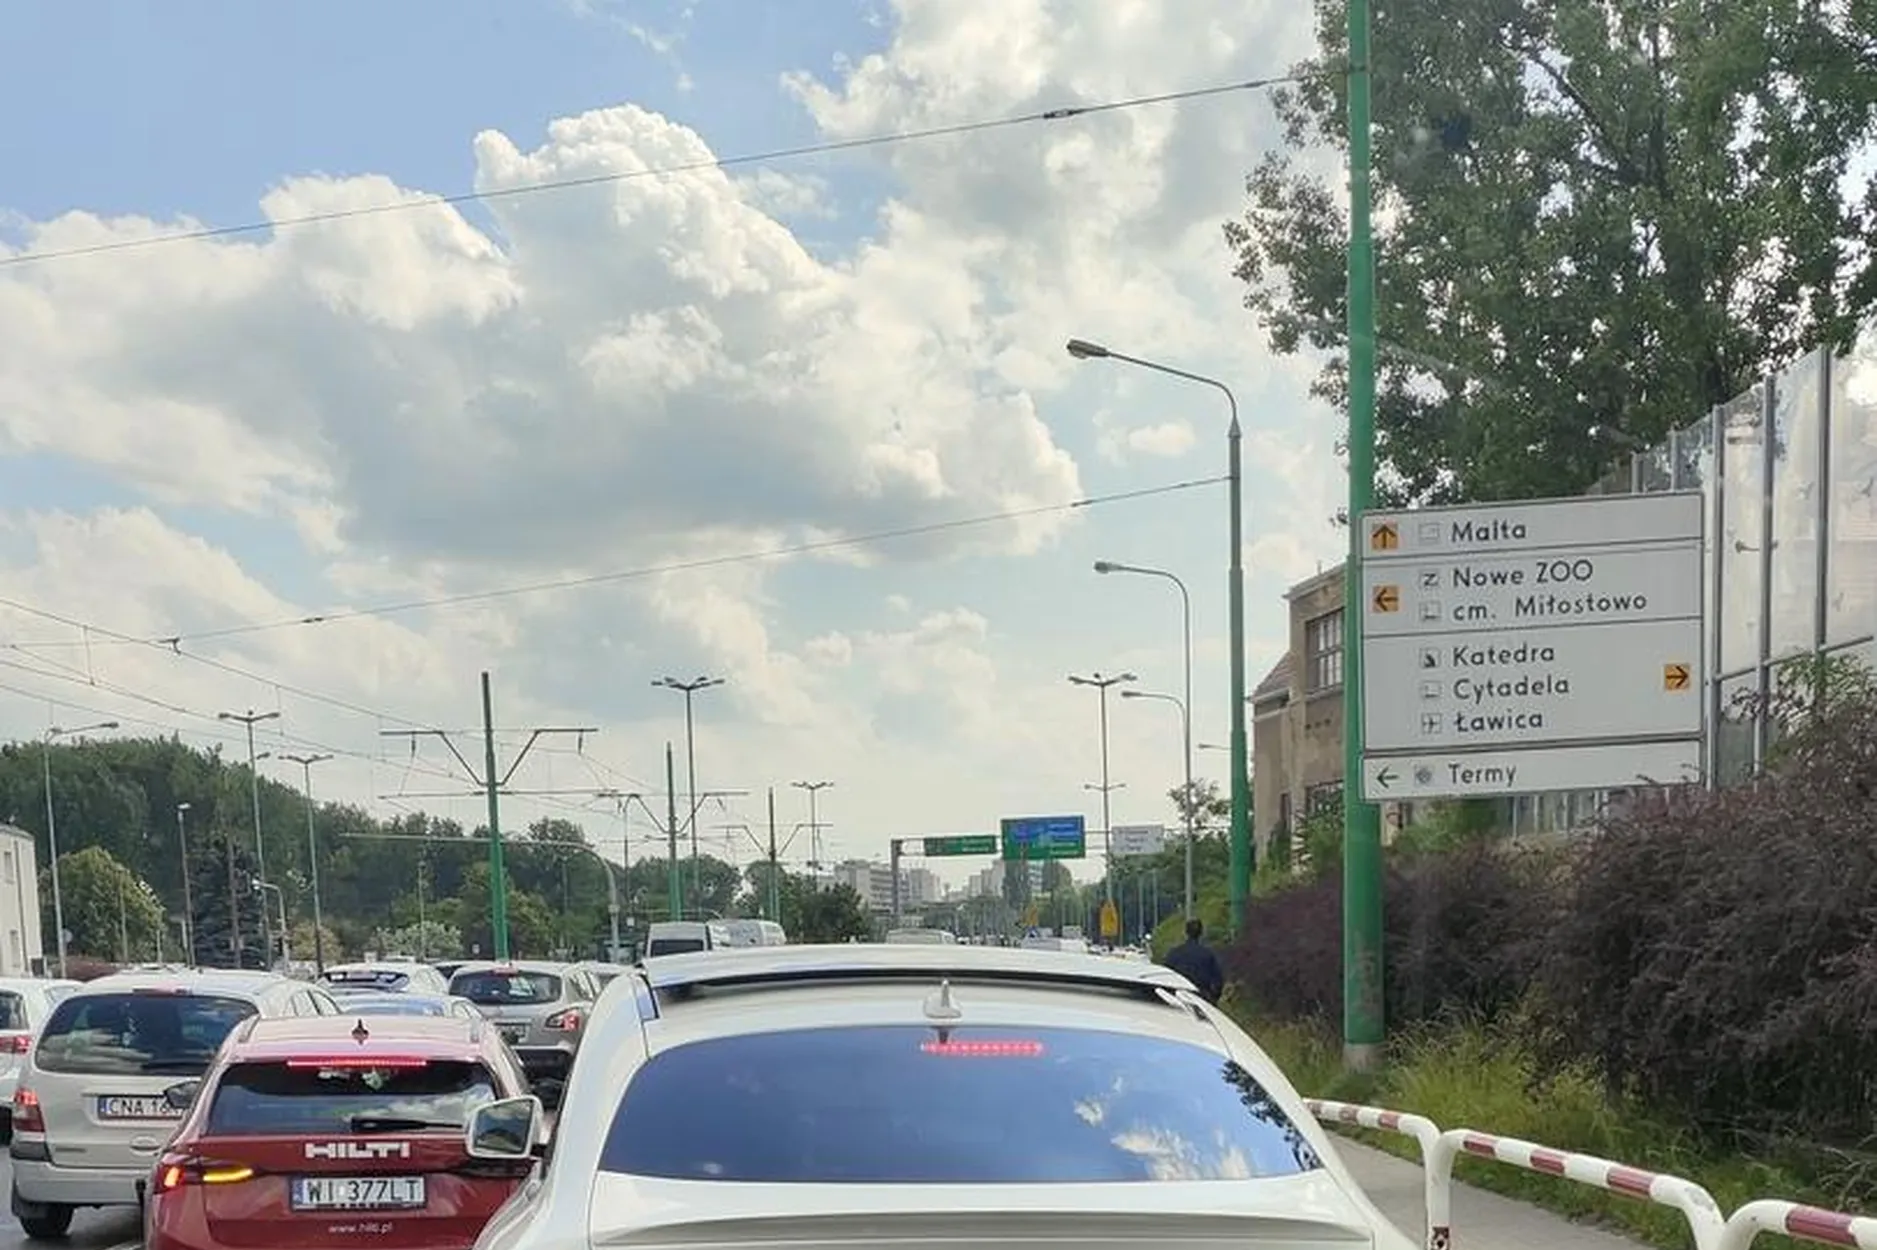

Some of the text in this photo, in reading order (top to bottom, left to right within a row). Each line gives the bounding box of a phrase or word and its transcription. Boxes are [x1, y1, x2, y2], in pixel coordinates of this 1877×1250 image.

[1451, 520, 1527, 543] Malta
[1452, 559, 1593, 588] Nowe ZOO
[1453, 593, 1647, 621] cm. Miłostowo
[1452, 643, 1555, 667] Katedra
[1453, 676, 1570, 704] Cytadela
[1454, 709, 1543, 733] Ławica
[1448, 764, 1517, 787] Termy
[110, 1099, 144, 1114] CNA
[305, 1142, 410, 1158] HILTI
[307, 1180, 418, 1201] WI 377LT
